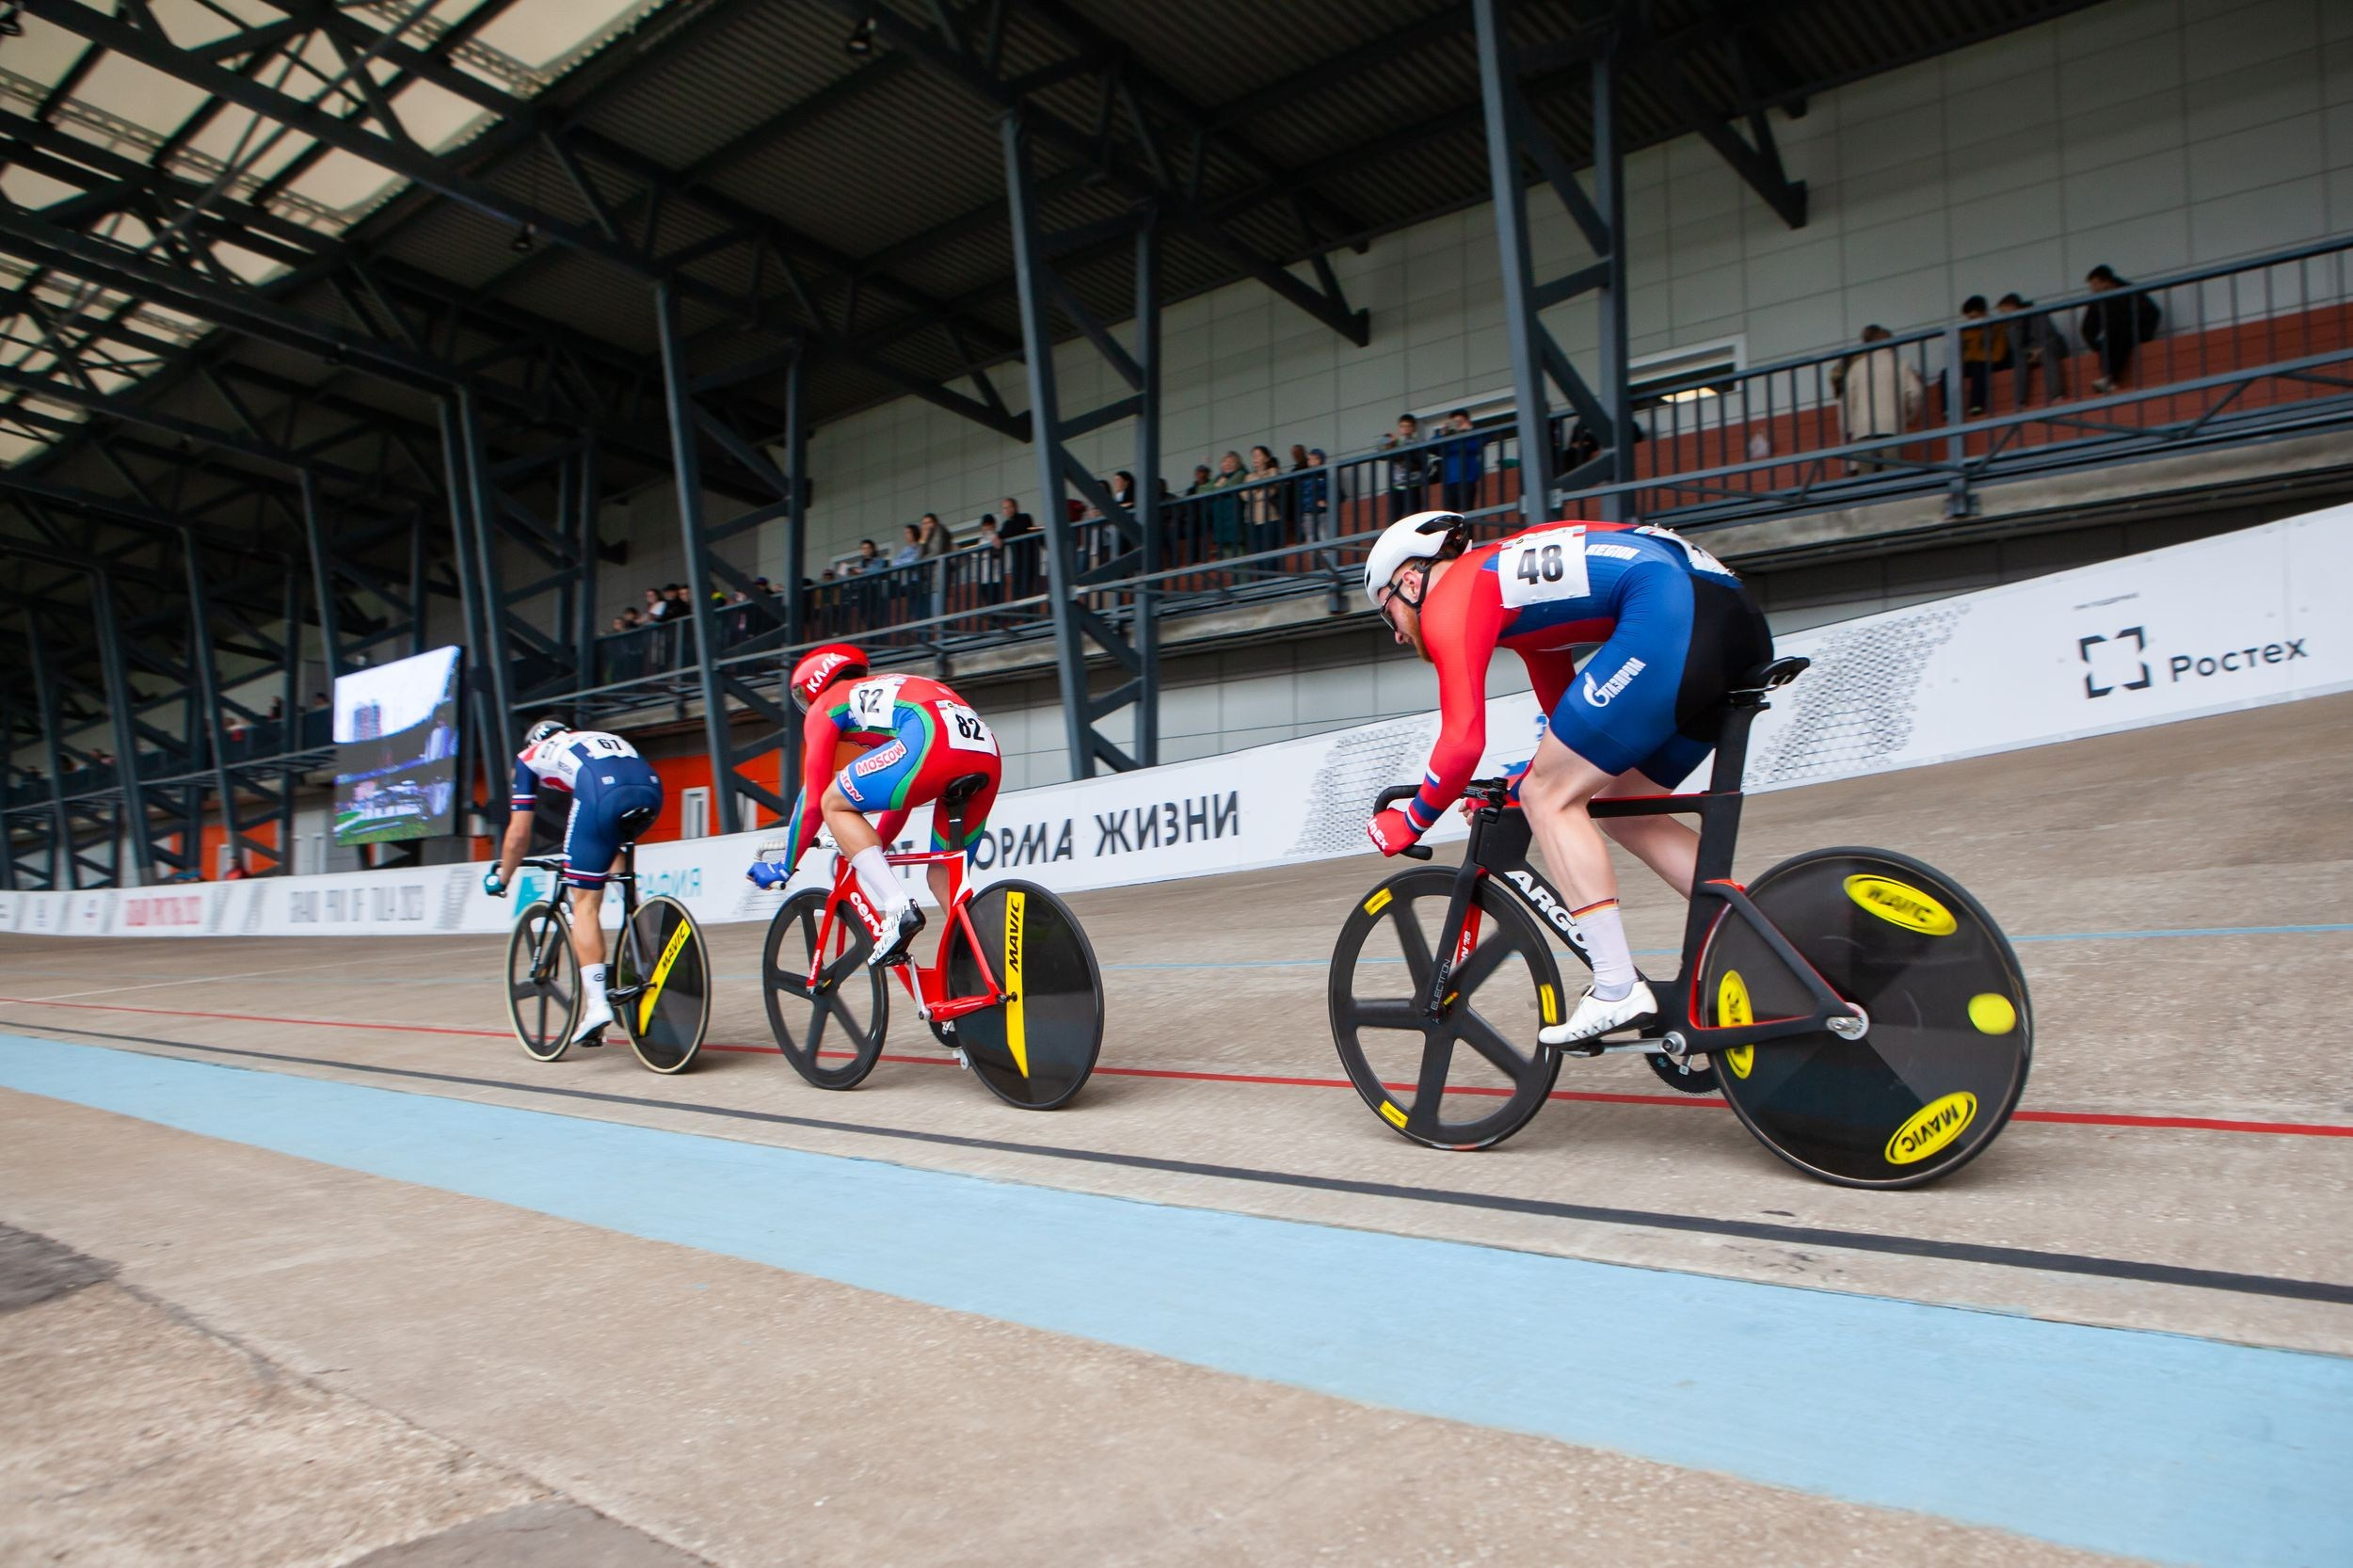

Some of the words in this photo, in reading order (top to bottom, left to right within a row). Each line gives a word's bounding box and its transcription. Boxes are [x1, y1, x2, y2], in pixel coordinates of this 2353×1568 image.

[1517, 544, 1564, 585] 48
[807, 652, 841, 694] KASK
[2169, 638, 2309, 682] Ростех
[598, 738, 622, 752] 61
[955, 713, 985, 742] 82
[856, 741, 905, 776] MOSCOW
[974, 817, 1073, 871] ОРМА
[1094, 790, 1240, 857] ЖИЗНИ
[850, 891, 884, 937] cerv
[1504, 871, 1591, 954] ARGO
[662, 925, 686, 974] MAVIC
[1009, 898, 1020, 974] MAVIC
[1901, 1103, 1960, 1153] MAVIC
